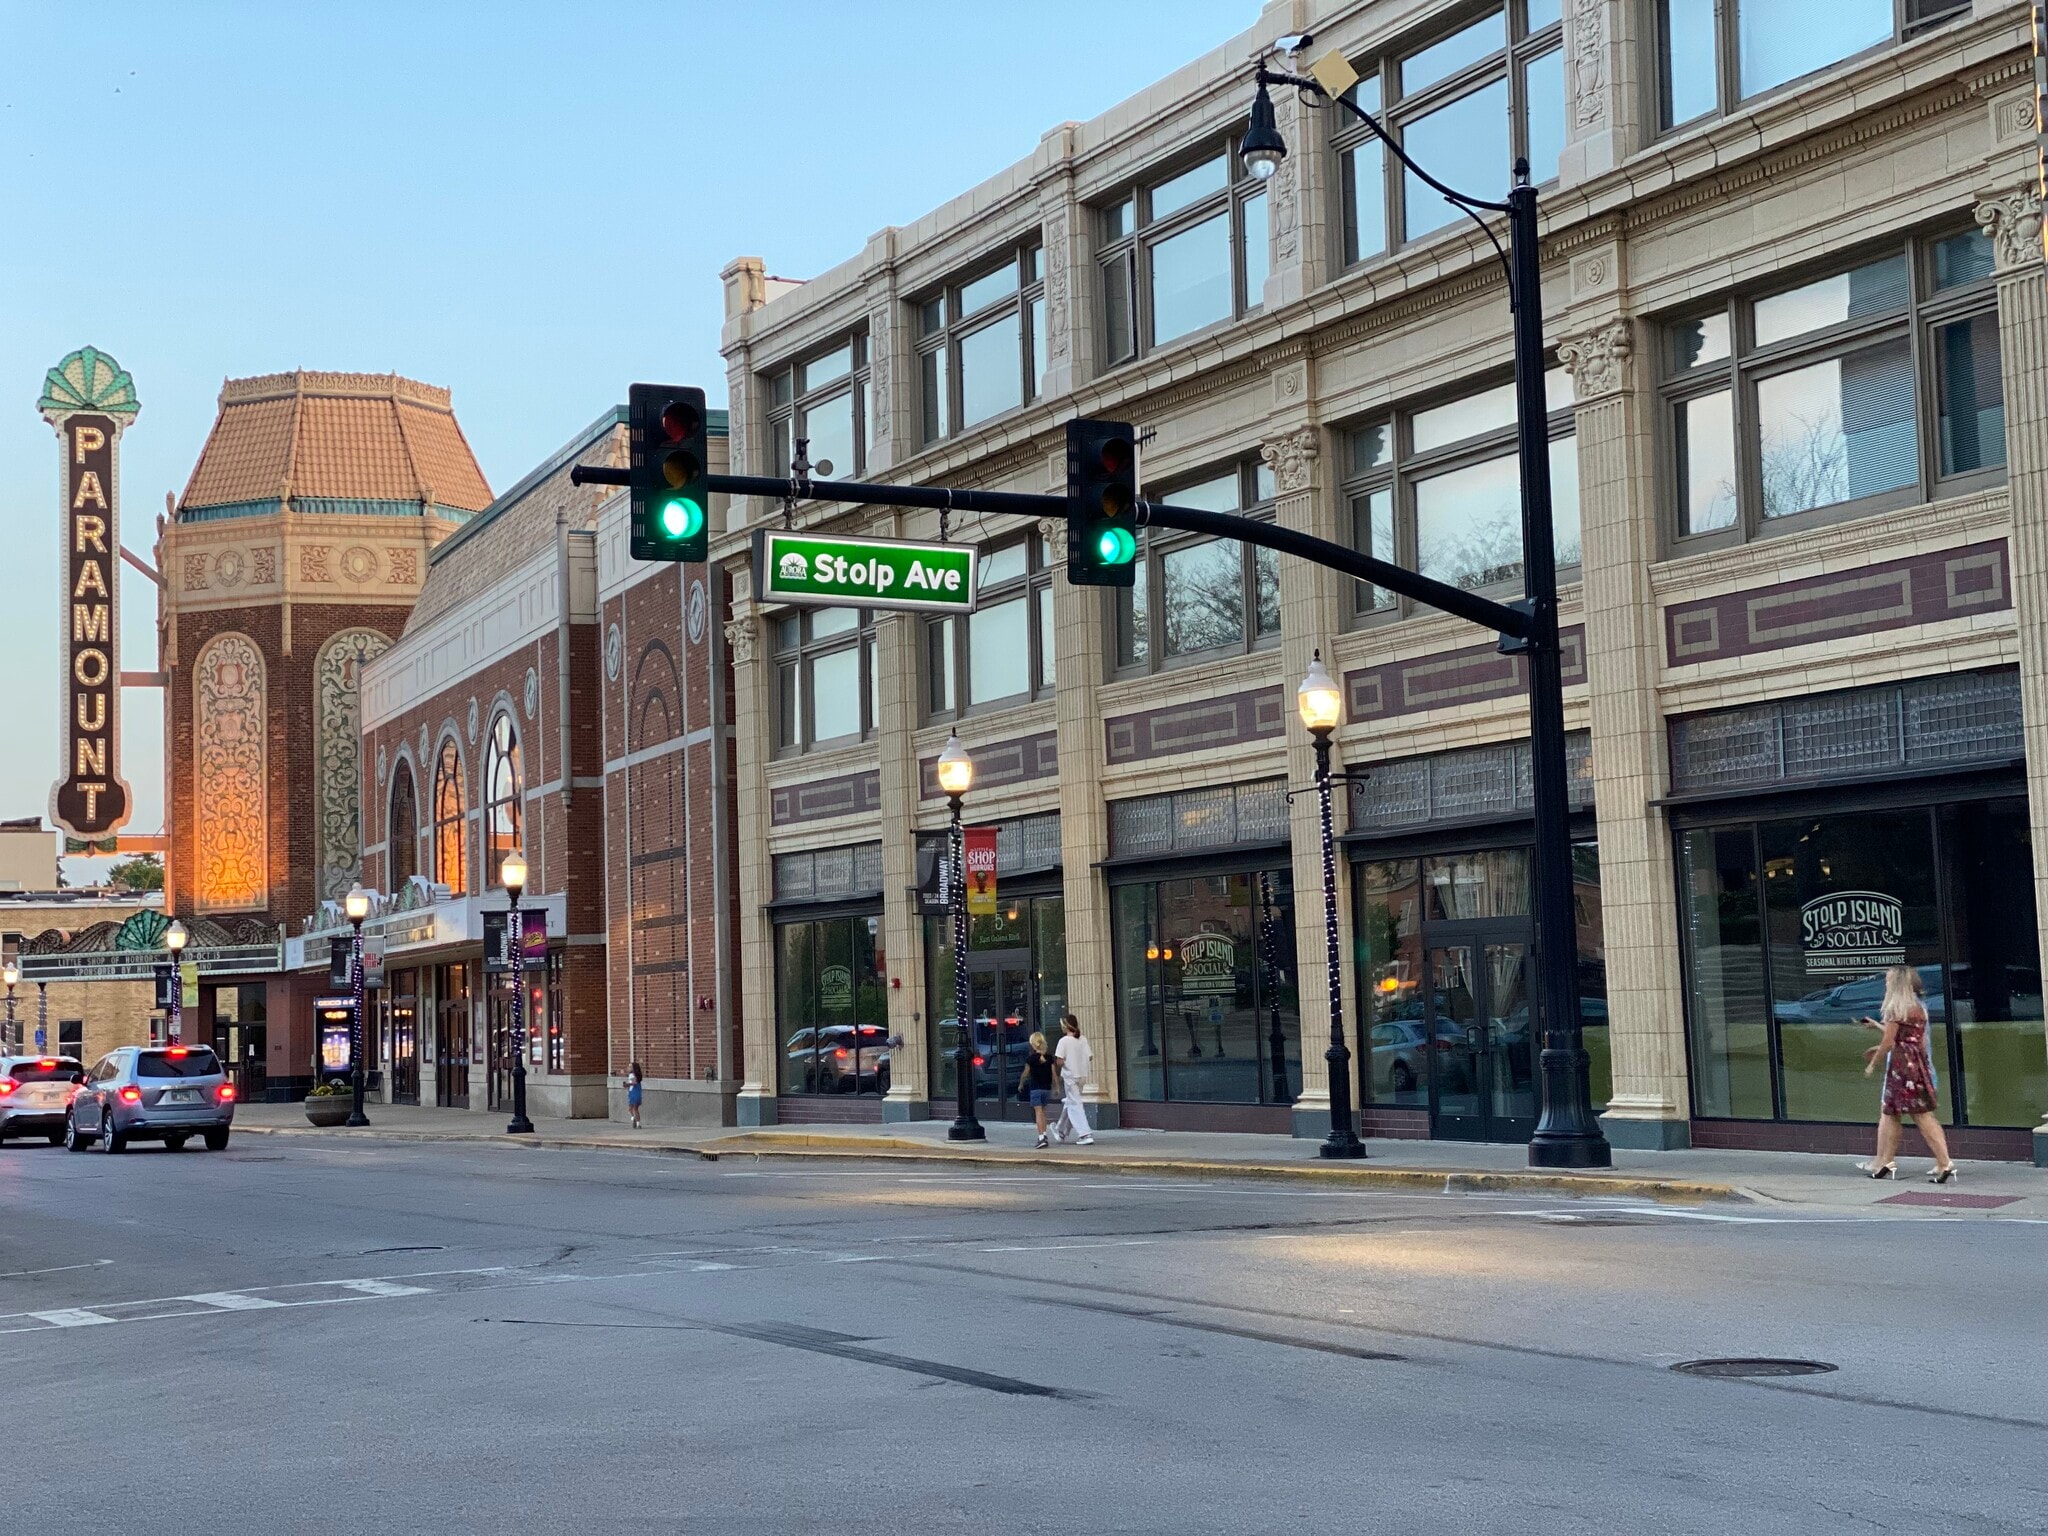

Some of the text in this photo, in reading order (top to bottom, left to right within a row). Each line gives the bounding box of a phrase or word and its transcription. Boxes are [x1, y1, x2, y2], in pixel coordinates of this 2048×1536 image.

[813, 553, 961, 593] Stolp Ave
[73, 426, 108, 823] PARAMOUNT
[968, 851, 996, 865] SHOP
[995, 913, 1004, 930] 5
[1802, 900, 1902, 942] STOLP ISLAND
[1826, 931, 1882, 948] SOCIAL
[58, 958, 82, 967] LITTLE
[87, 957, 105, 966] SHOP
[111, 956, 119, 964] OF
[1181, 940, 1234, 971] STOLP ISLAND
[1806, 954, 1906, 967] SEASONAL KITCHEN & STEAKHOUSE
[74, 967, 116, 976] SPONSORED
[121, 966, 131, 974] BY
[1193, 962, 1223, 976] SOCIAL
